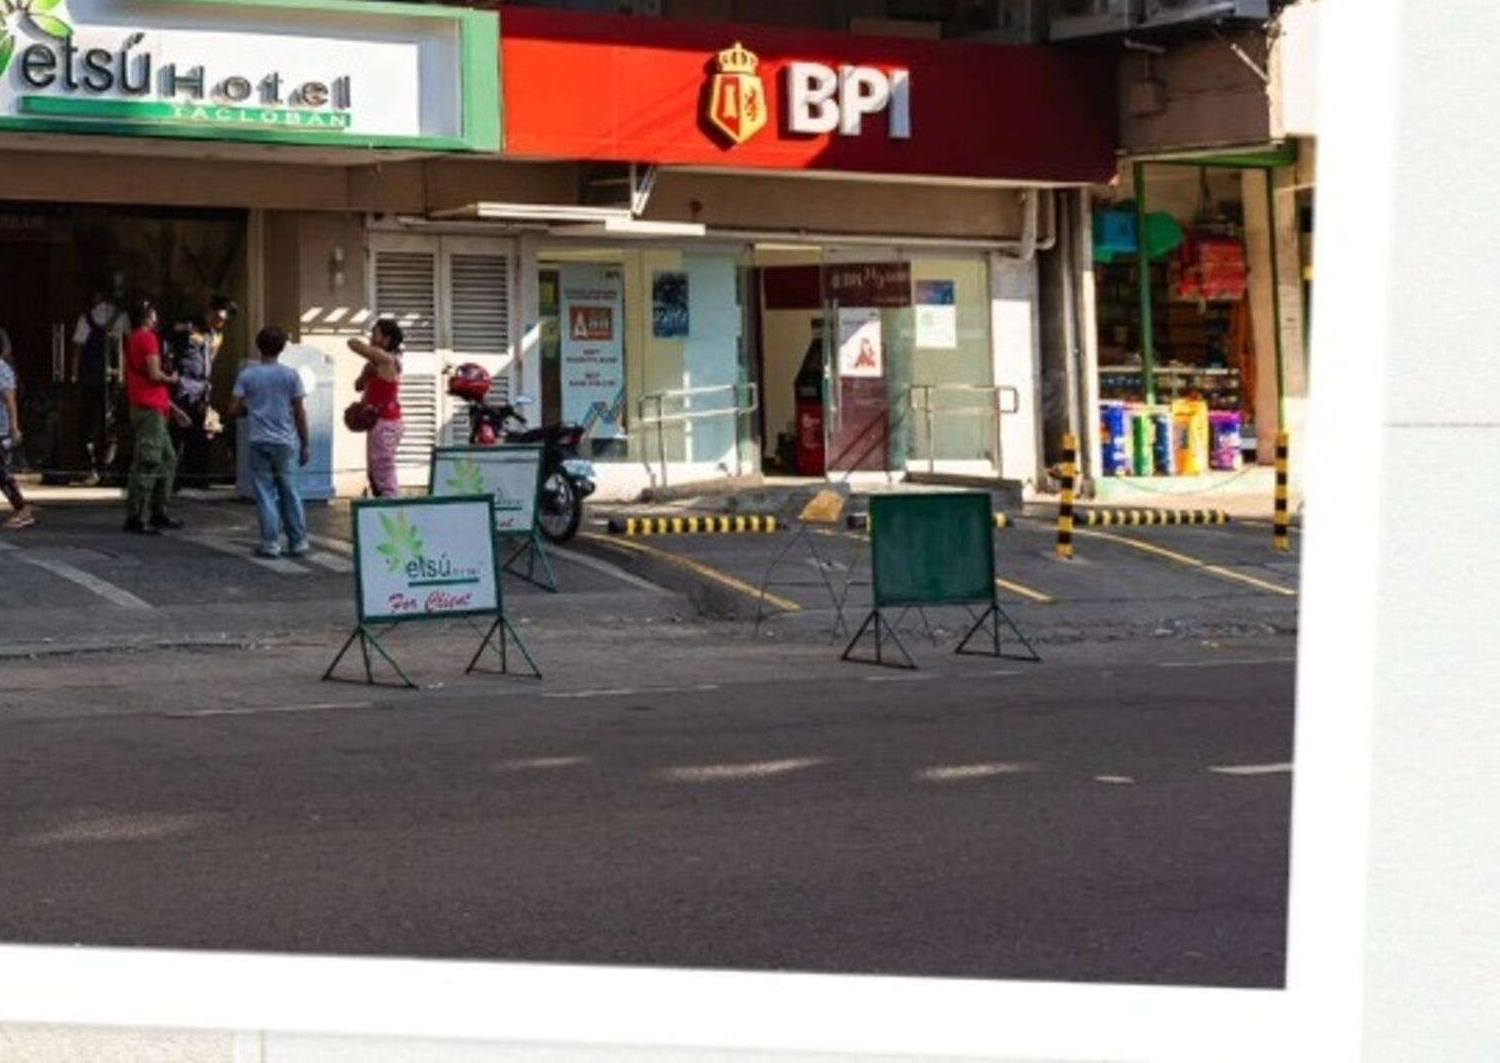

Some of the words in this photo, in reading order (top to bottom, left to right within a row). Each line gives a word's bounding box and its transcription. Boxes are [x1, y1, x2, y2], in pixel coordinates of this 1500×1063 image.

[20, 33, 151, 96] etsú
[160, 62, 352, 109] Hotel
[173, 104, 348, 128] TACLOBAN
[788, 61, 910, 138] BPI
[388, 593, 417, 614] For
[425, 590, 472, 614] Client
